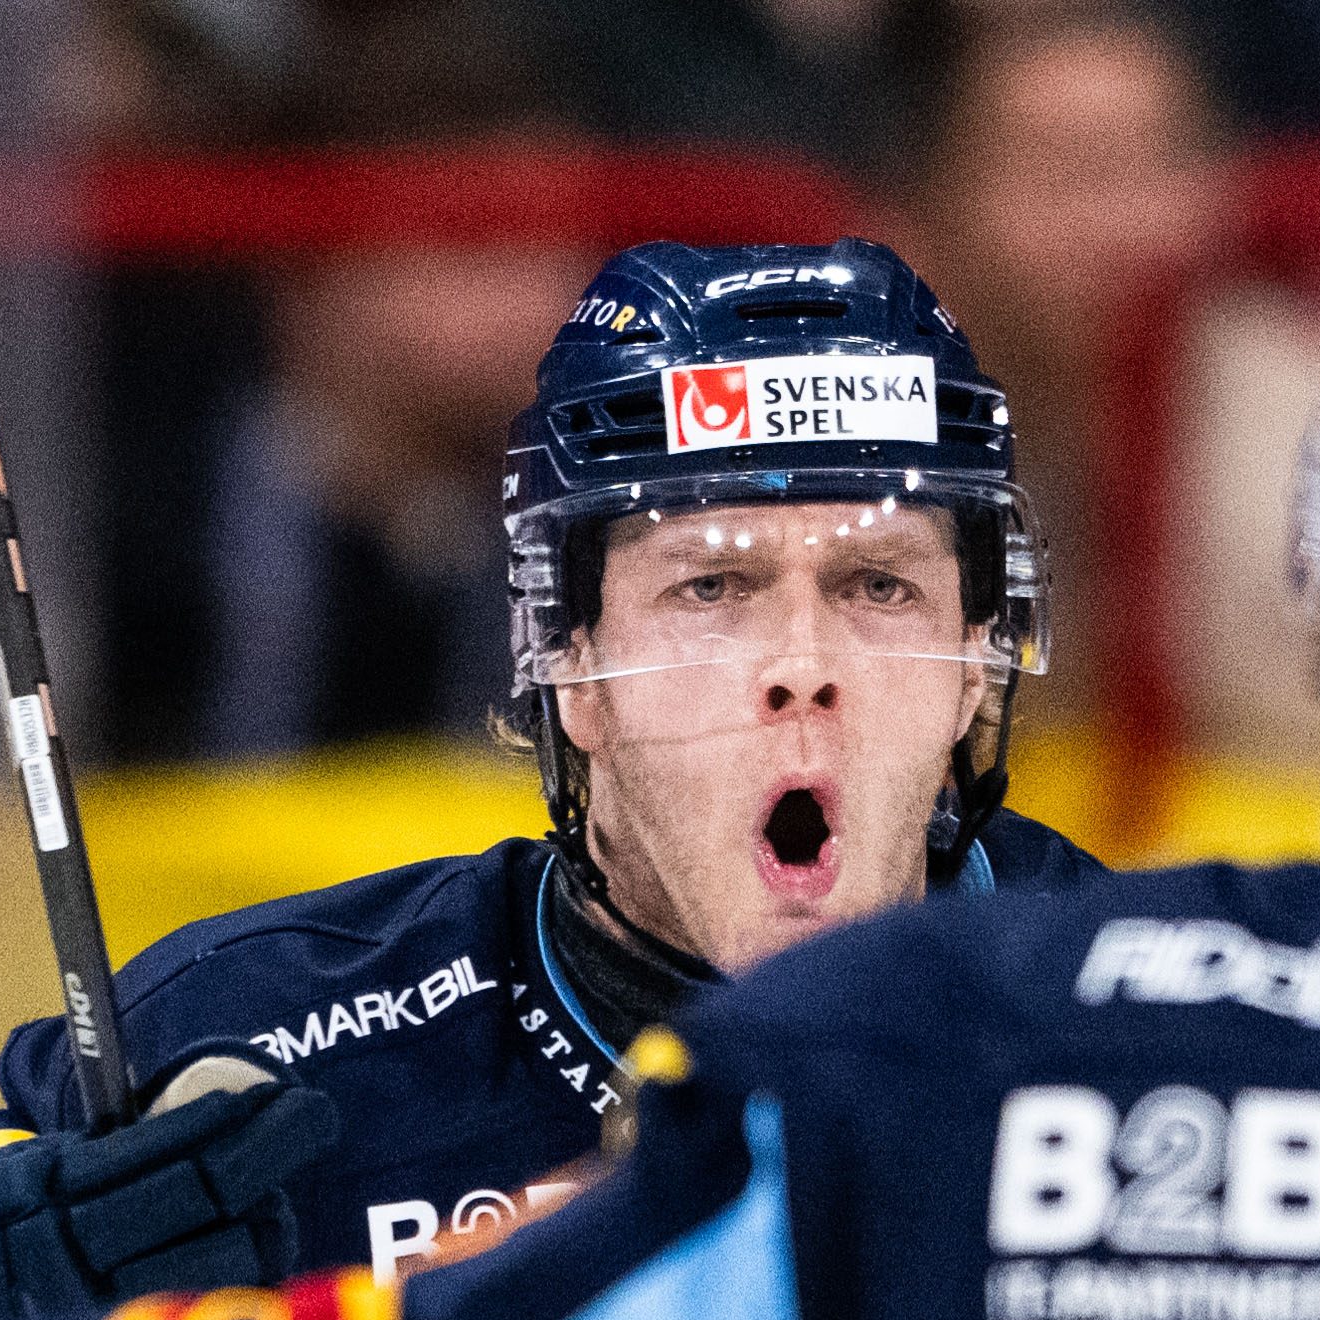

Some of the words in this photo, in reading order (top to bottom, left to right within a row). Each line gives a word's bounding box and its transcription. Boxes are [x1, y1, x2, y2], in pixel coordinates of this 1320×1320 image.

[703, 266, 853, 298] CCM
[763, 376, 927, 405] SVENSKA
[766, 409, 854, 437] SPEL
[418, 956, 497, 1019] BIL
